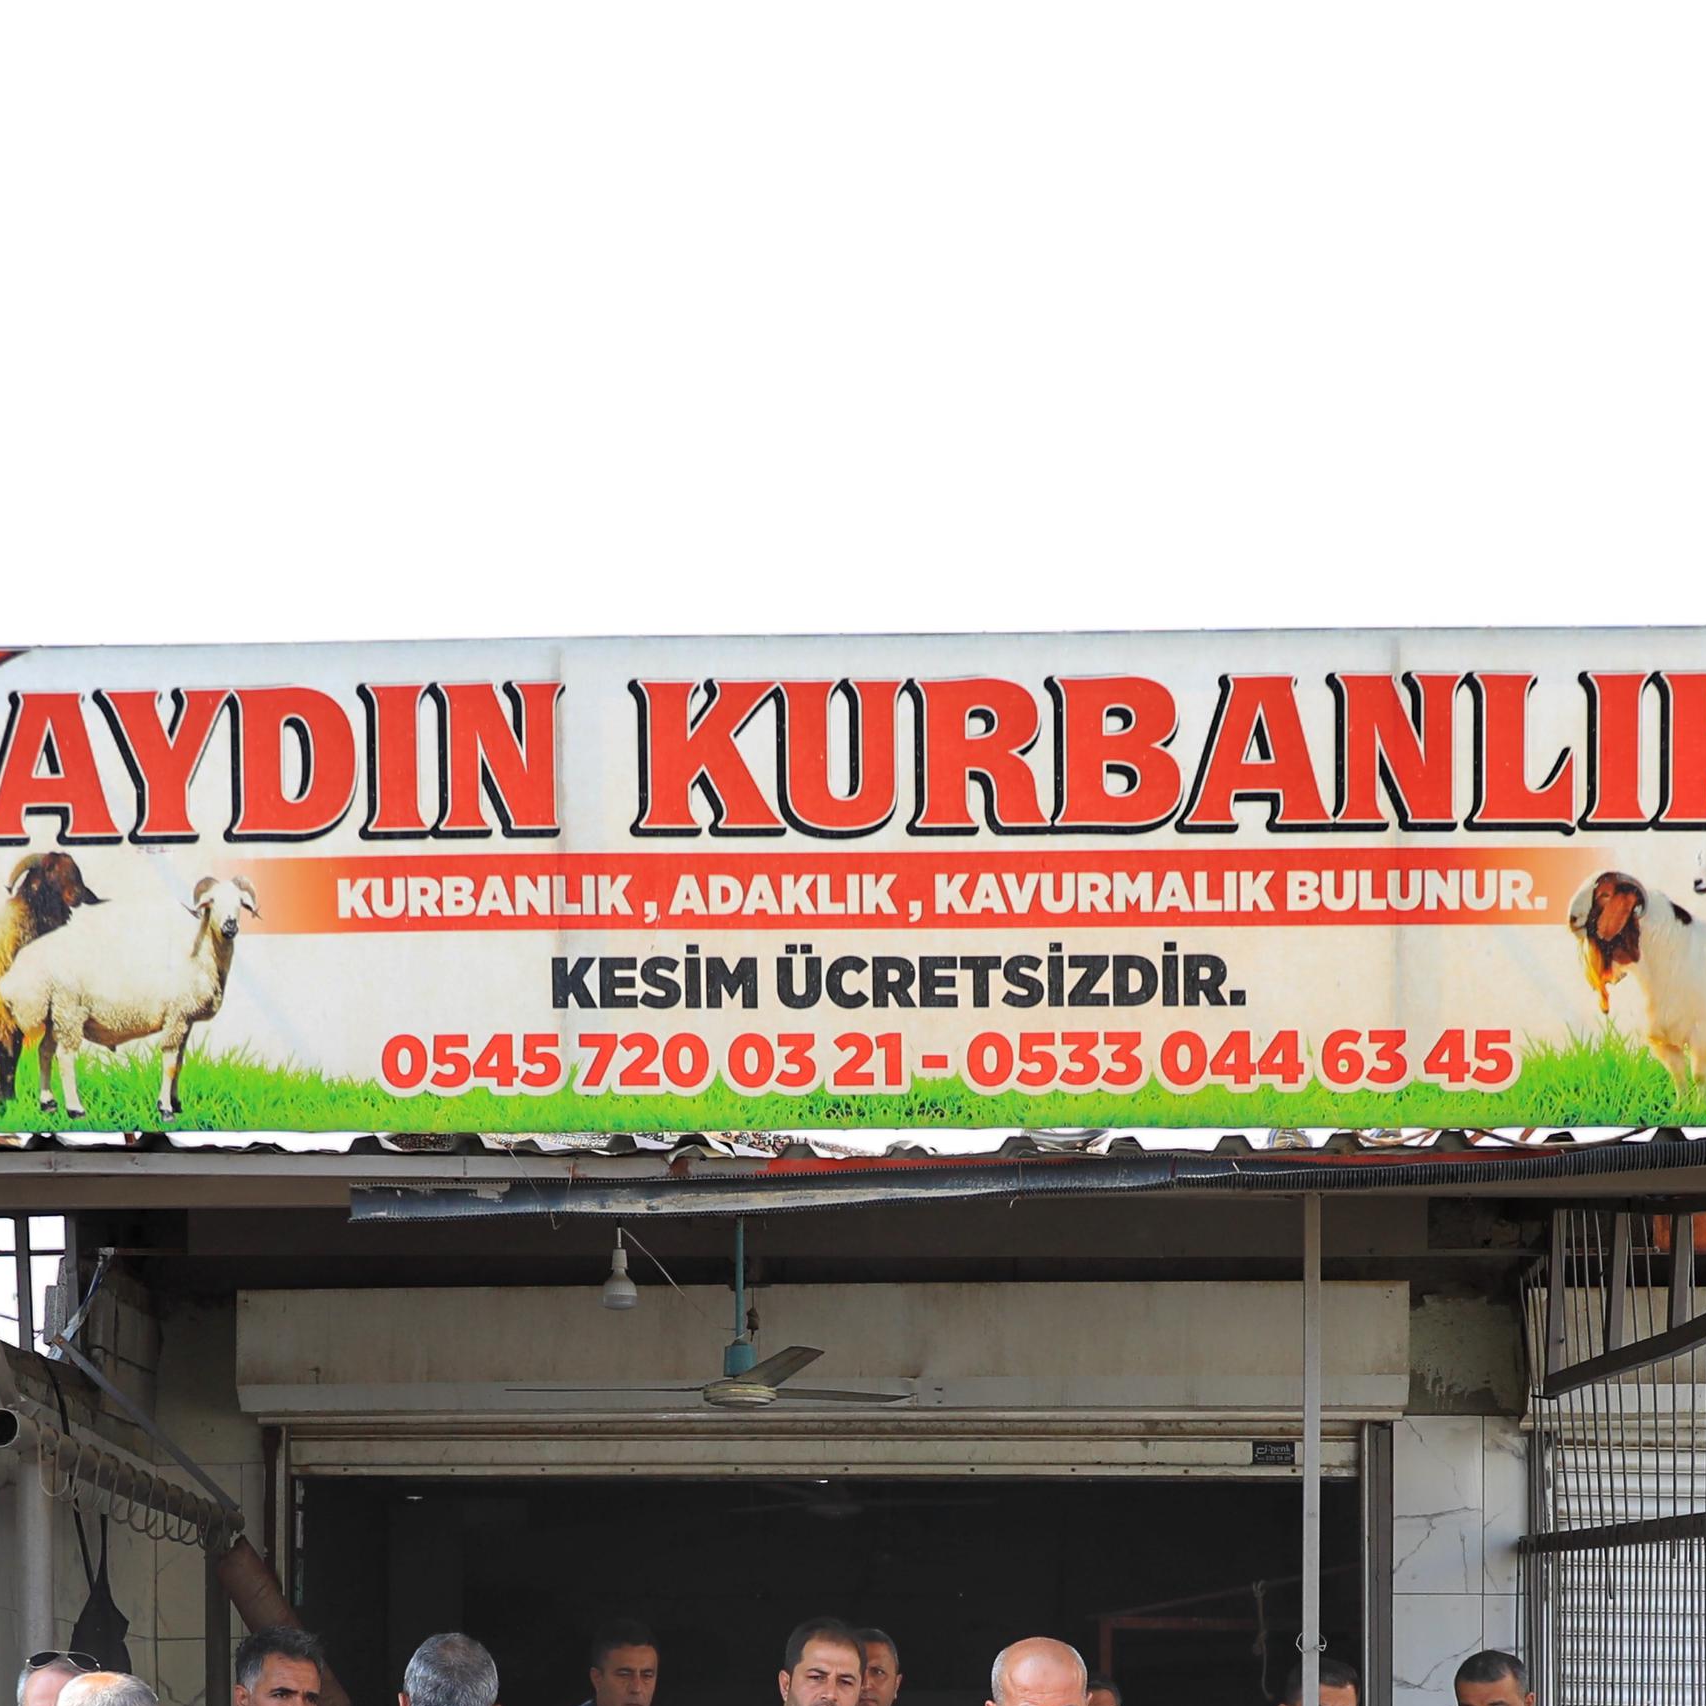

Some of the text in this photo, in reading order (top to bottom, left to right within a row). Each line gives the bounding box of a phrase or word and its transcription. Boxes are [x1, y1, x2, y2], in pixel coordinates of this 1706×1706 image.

[338, 875, 634, 919] KURBANLIK
[669, 874, 898, 915] ADAKLIK
[935, 870, 1275, 914] KAVURMALIK
[1287, 869, 1549, 911] BULUNUR.
[552, 941, 1246, 1010] KESİM ÜCRETSİZDİR.
[381, 1033, 562, 1089] 0545
[580, 1032, 710, 1088] 720
[728, 1033, 817, 1088] 03
[833, 1032, 902, 1087] 21
[966, 1031, 1143, 1087] 0533
[1160, 1030, 1305, 1086] 044
[1322, 1029, 1408, 1085] 63
[1424, 1029, 1513, 1084] 45
